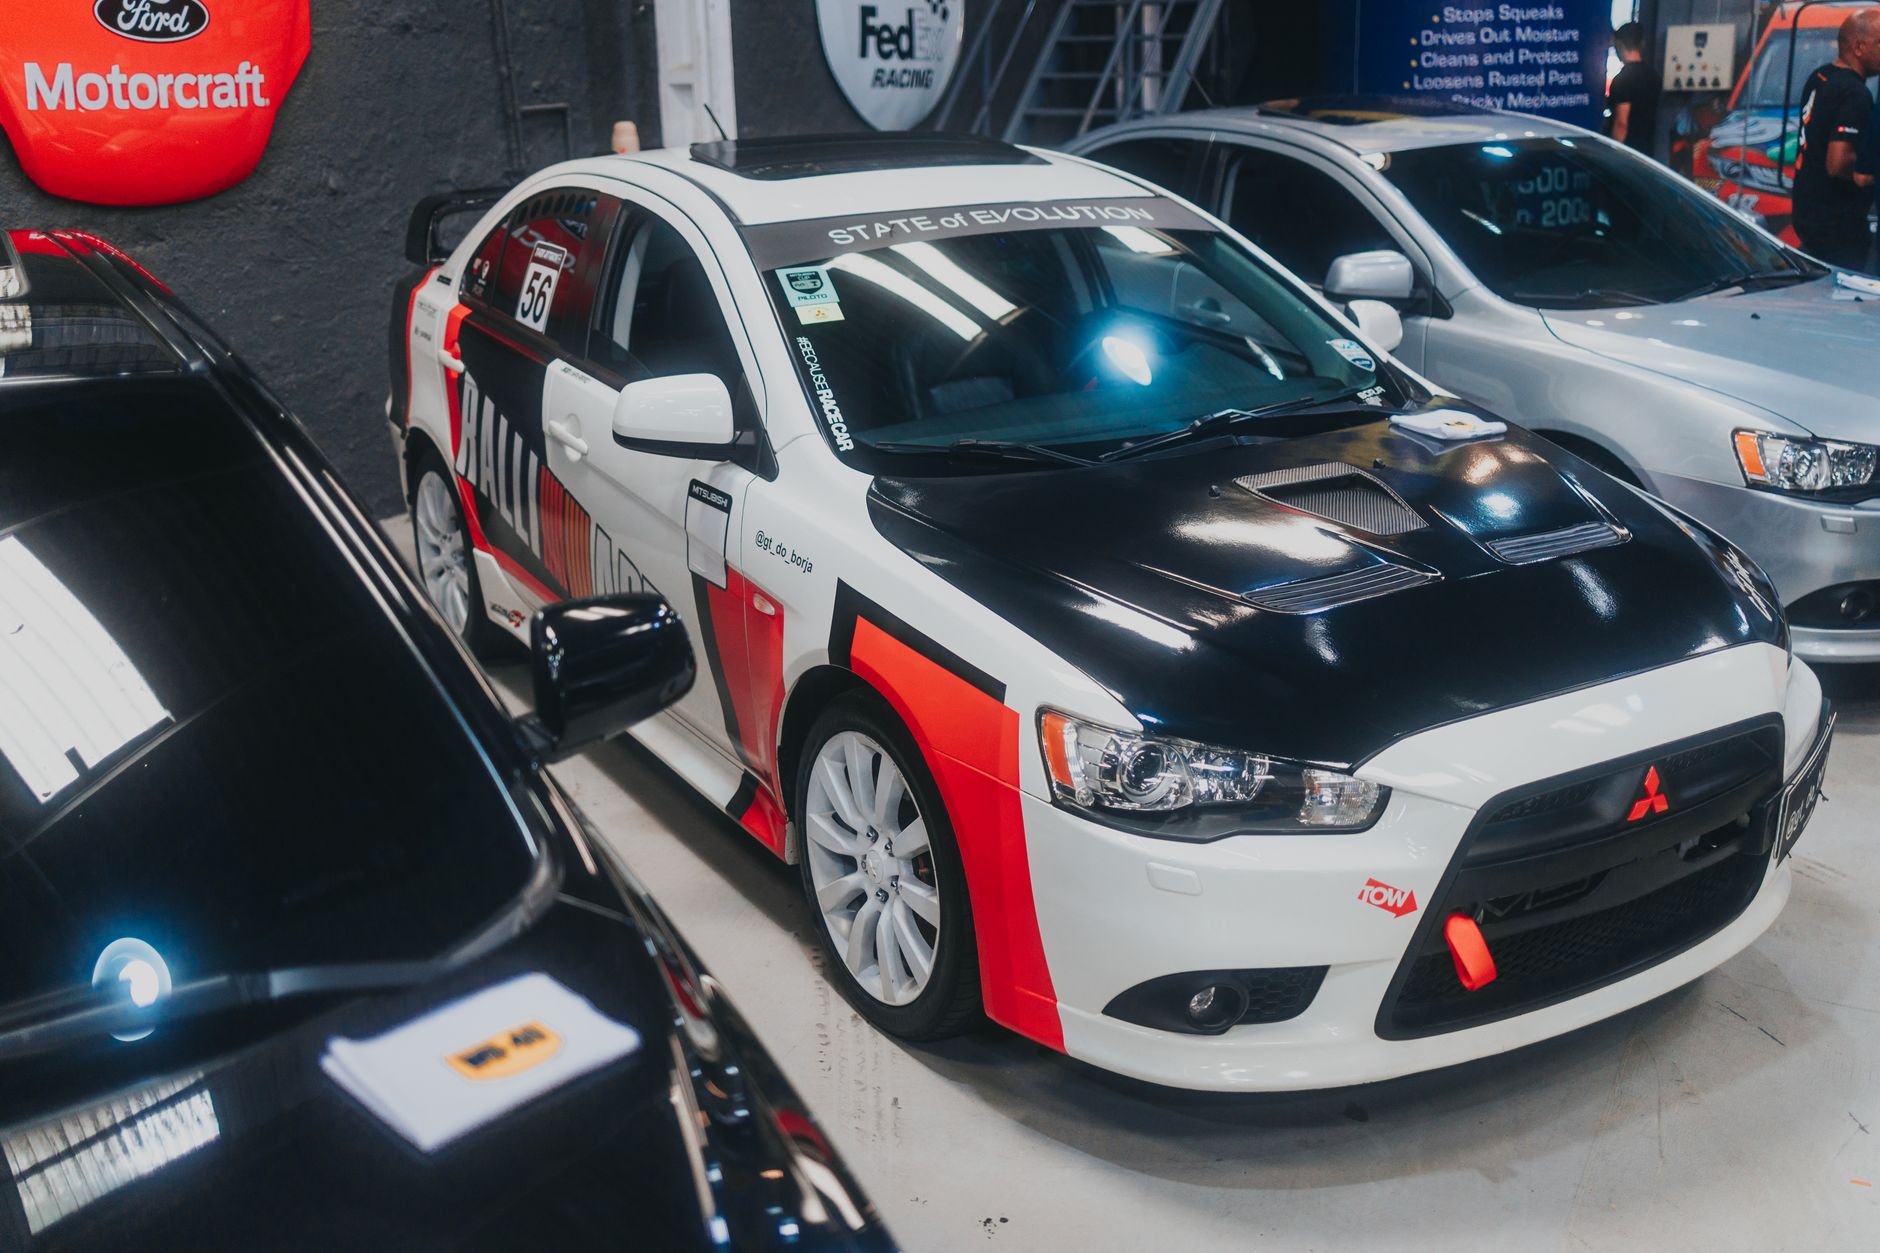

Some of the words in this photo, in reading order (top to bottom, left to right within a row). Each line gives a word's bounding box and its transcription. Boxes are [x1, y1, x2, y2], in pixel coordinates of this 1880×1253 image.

[117, 0, 190, 32] Ford
[1443, 6, 1494, 24] Stops
[1499, 4, 1564, 23] Squeaks
[1421, 29, 1476, 46] Drives
[1480, 27, 1511, 43] Out
[1515, 27, 1579, 42] Moisture
[1421, 51, 1479, 68] Cleans
[1483, 49, 1514, 65] and
[1518, 48, 1579, 64] Protects
[23, 61, 265, 111] Motorcraft
[871, 67, 934, 89] RACING
[1413, 74, 1484, 90] Loosens
[1488, 71, 1545, 87] Rusted
[1548, 71, 1583, 85] Parts
[1507, 92, 1590, 108] Mechanisms
[828, 215, 939, 245] STATE
[940, 212, 969, 229] of
[969, 206, 1155, 225] EVOLUTION
[521, 271, 552, 324] 56
[755, 530, 813, 573] @gt_do_borja
[1360, 885, 1408, 908] TOW
